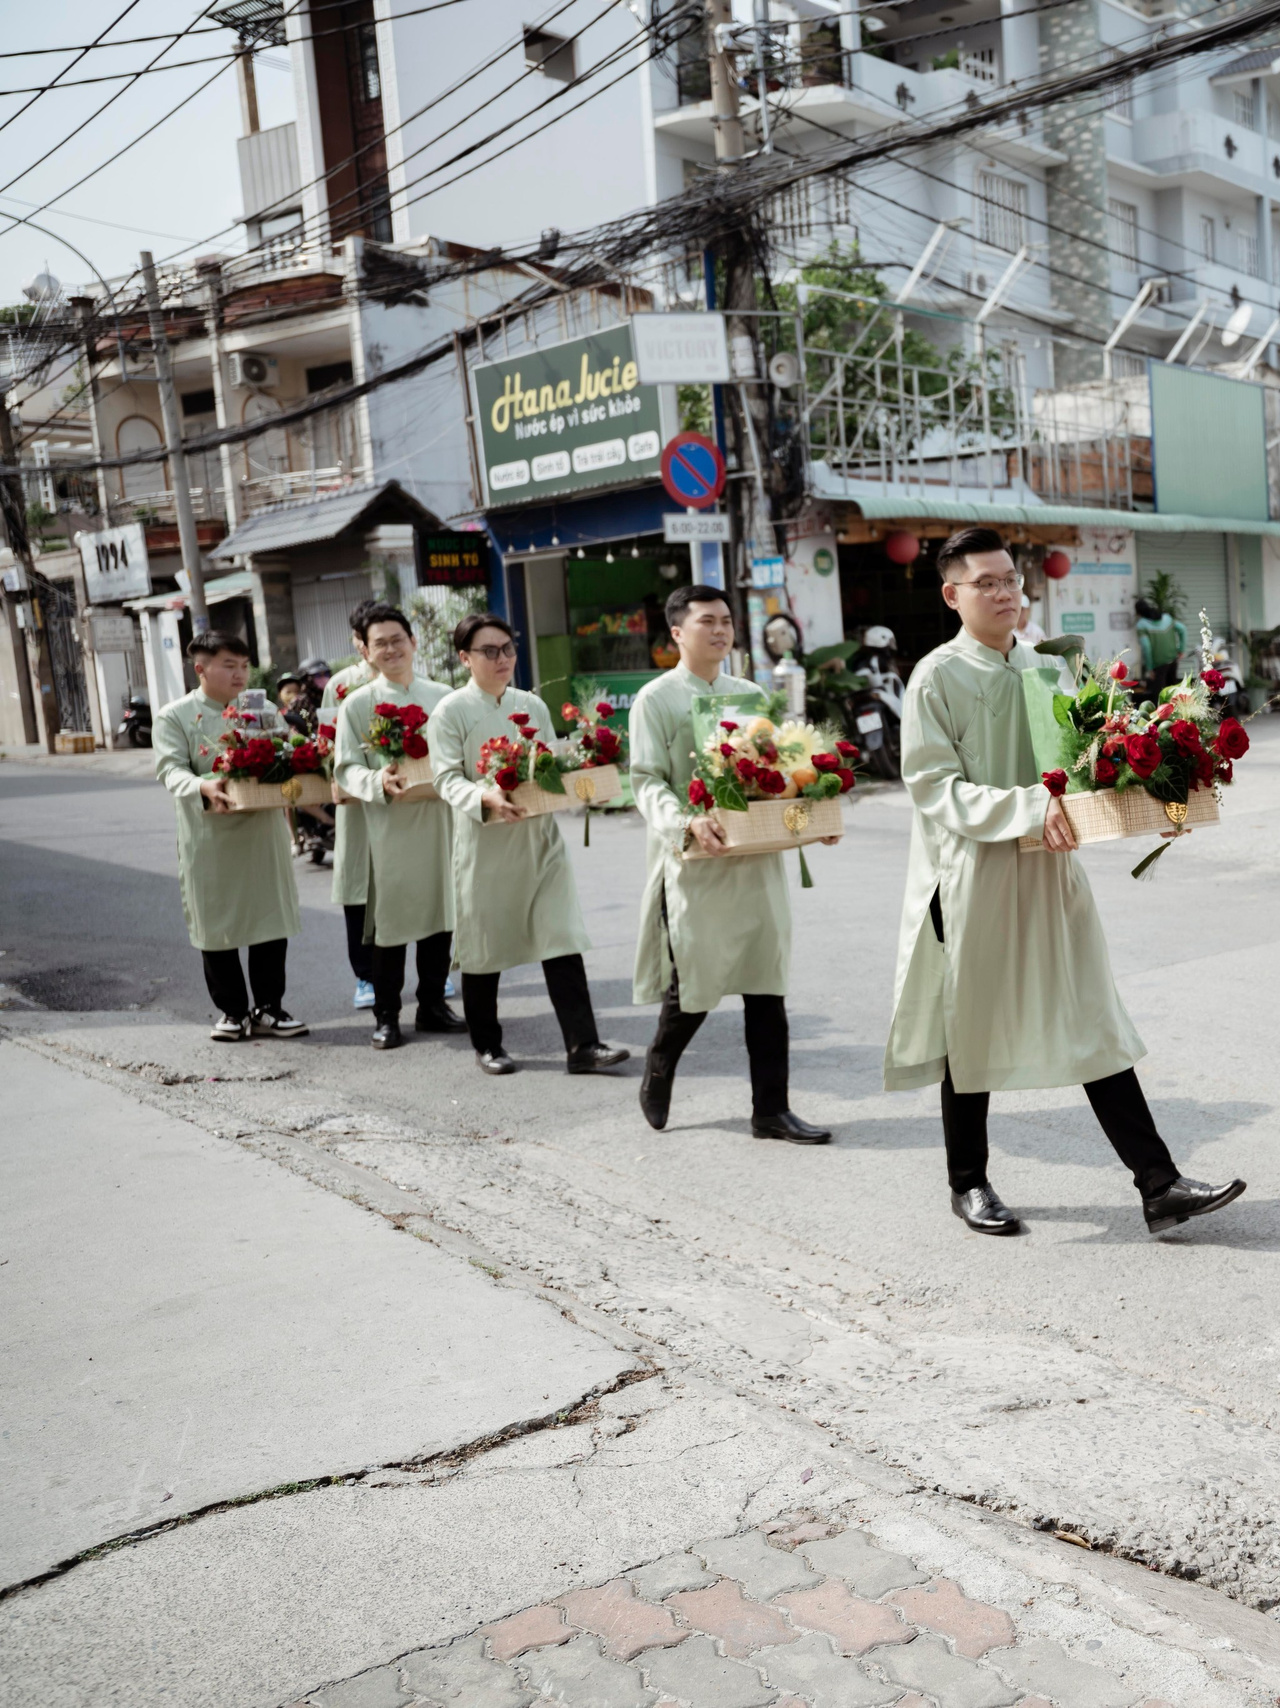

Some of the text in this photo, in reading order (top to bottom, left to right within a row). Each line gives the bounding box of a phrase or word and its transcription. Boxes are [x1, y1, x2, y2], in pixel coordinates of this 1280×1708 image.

[644, 339, 718, 360] VICTORY
[491, 372, 573, 433] Hana
[514, 418, 547, 440] Nước
[549, 413, 565, 435] ép
[581, 402, 607, 425] sức
[608, 394, 641, 418] khỏe
[430, 553, 460, 568] SINH
